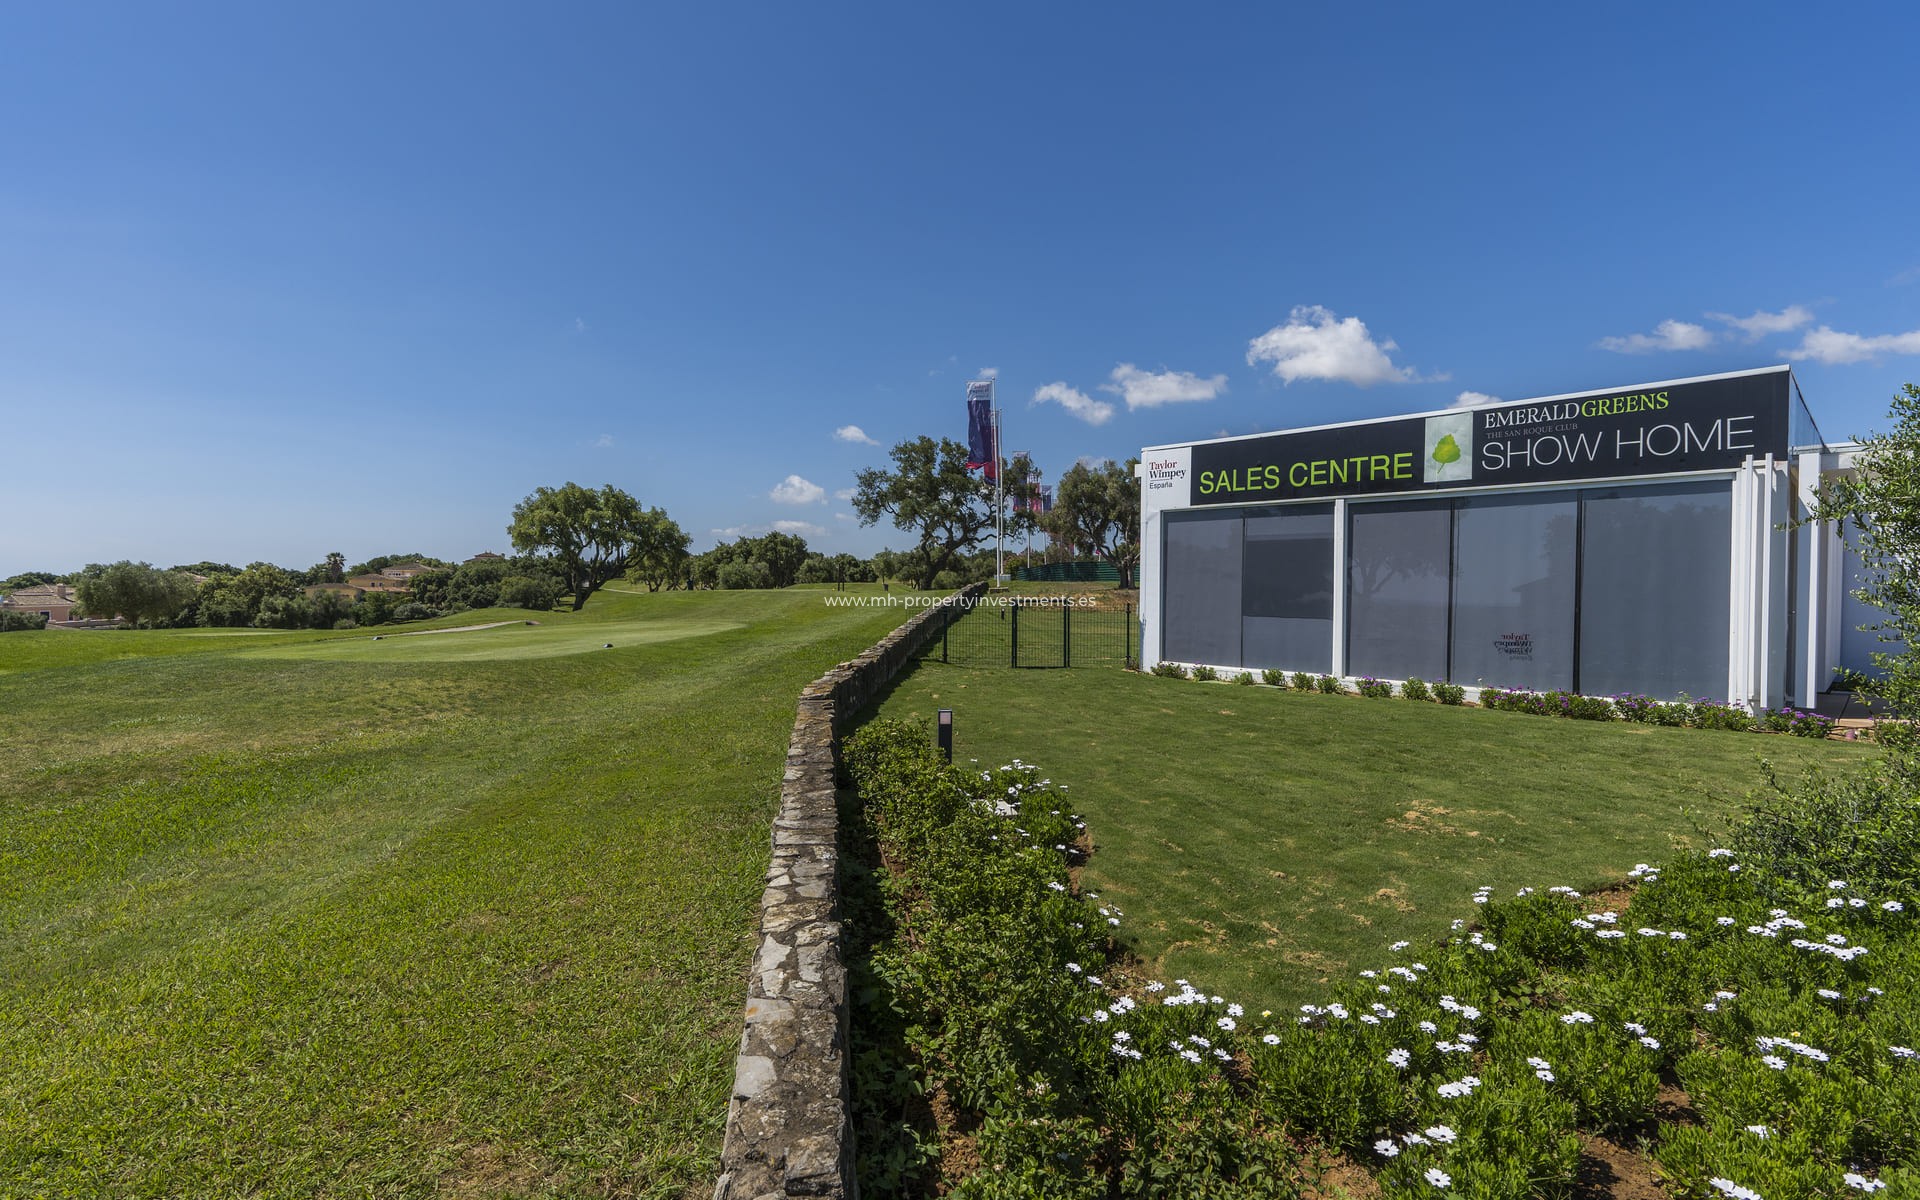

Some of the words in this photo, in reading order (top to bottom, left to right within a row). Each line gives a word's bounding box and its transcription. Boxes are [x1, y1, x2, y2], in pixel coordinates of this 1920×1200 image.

[1486, 431, 1503, 439] THE
[1504, 429, 1521, 438] SAN
[1523, 425, 1553, 436] ROQUE
[1555, 423, 1578, 432] CLUB
[1481, 431, 1603, 470] SHOW
[1616, 415, 1754, 459] HOME
[1149, 459, 1178, 471] Taylor
[1149, 469, 1186, 480] Wimpey
[1199, 465, 1280, 494] SALES
[1289, 452, 1413, 487] CENTRE
[1149, 481, 1173, 490] España
